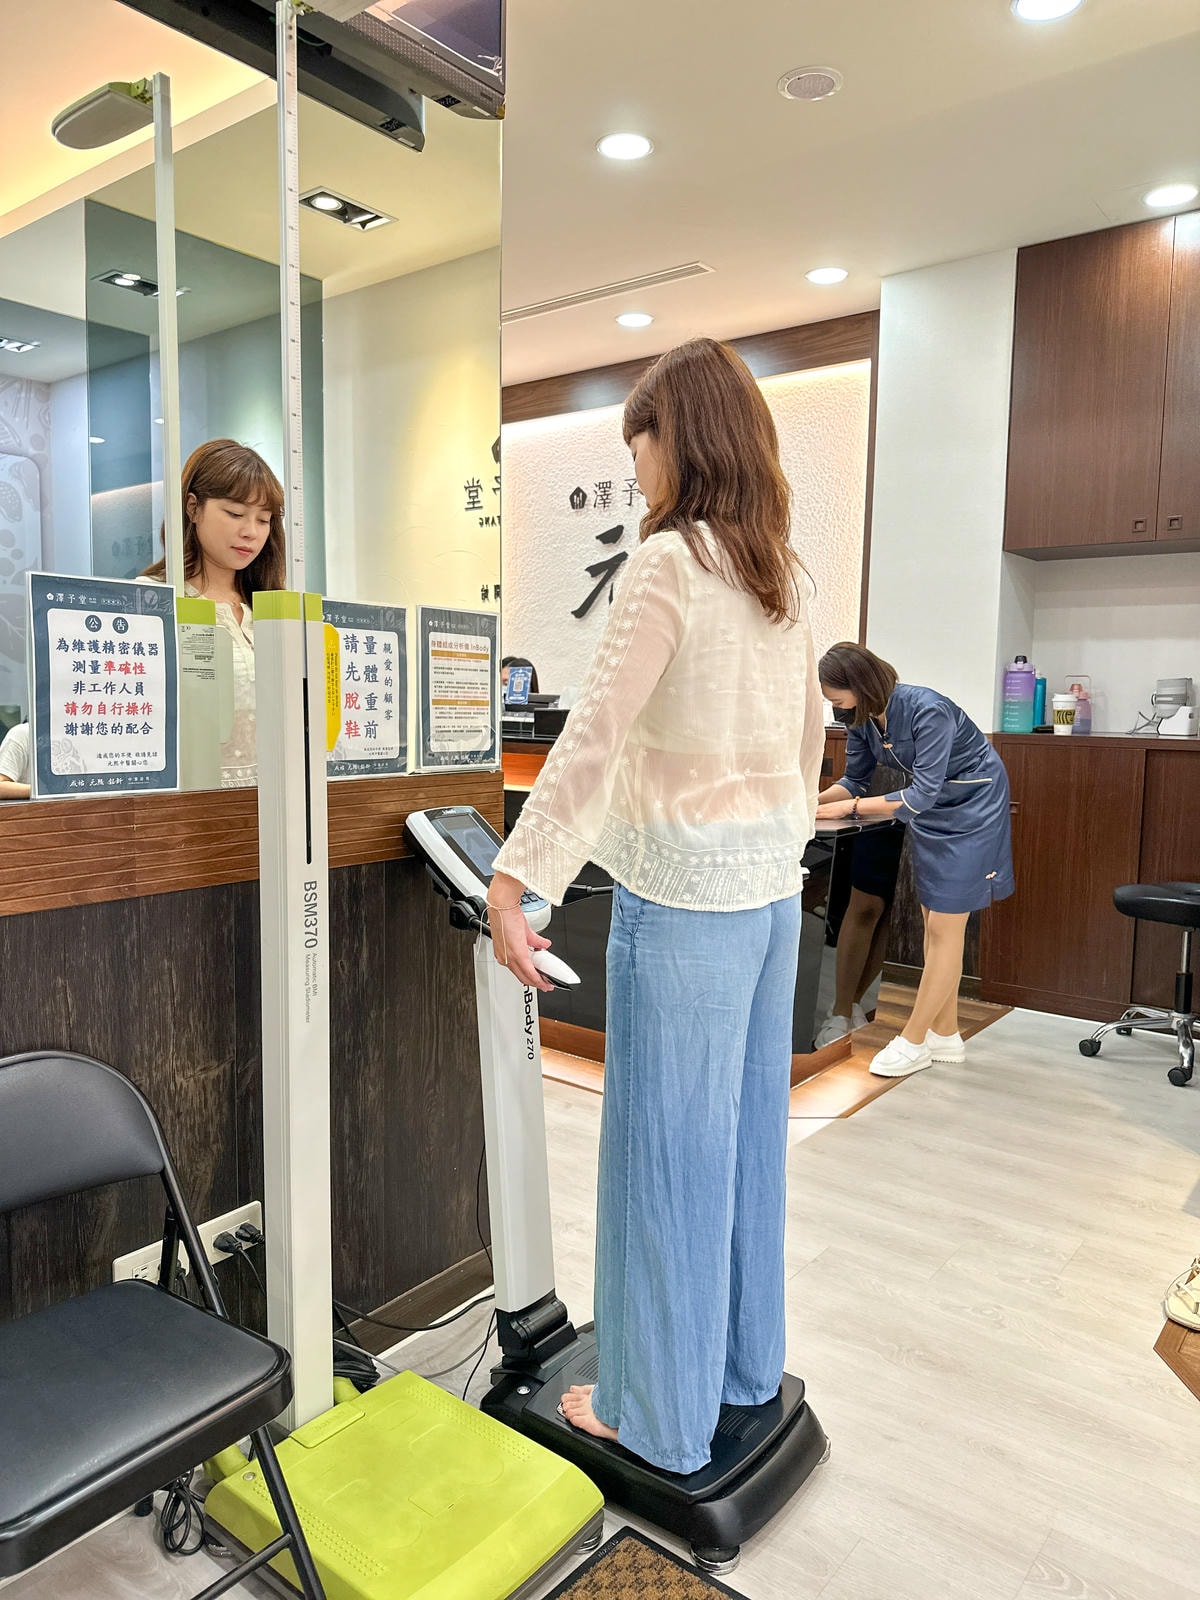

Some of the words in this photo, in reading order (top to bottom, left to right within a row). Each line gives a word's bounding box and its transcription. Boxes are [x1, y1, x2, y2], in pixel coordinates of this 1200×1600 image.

[56, 638, 159, 656] 為維護精密儀器
[72, 660, 146, 675] 測量準確性
[72, 681, 144, 696] 非工作人員
[343, 633, 361, 739] 請先脫鞋
[363, 635, 379, 740] 量體重前
[383, 642, 393, 721] 親愛的顧客
[64, 702, 153, 716] 請勿自行操作
[64, 721, 153, 736] 謝謝您的配合
[304, 880, 318, 949] BSM370
[524, 984, 535, 1035] nBody
[527, 1038, 535, 1060] 270
